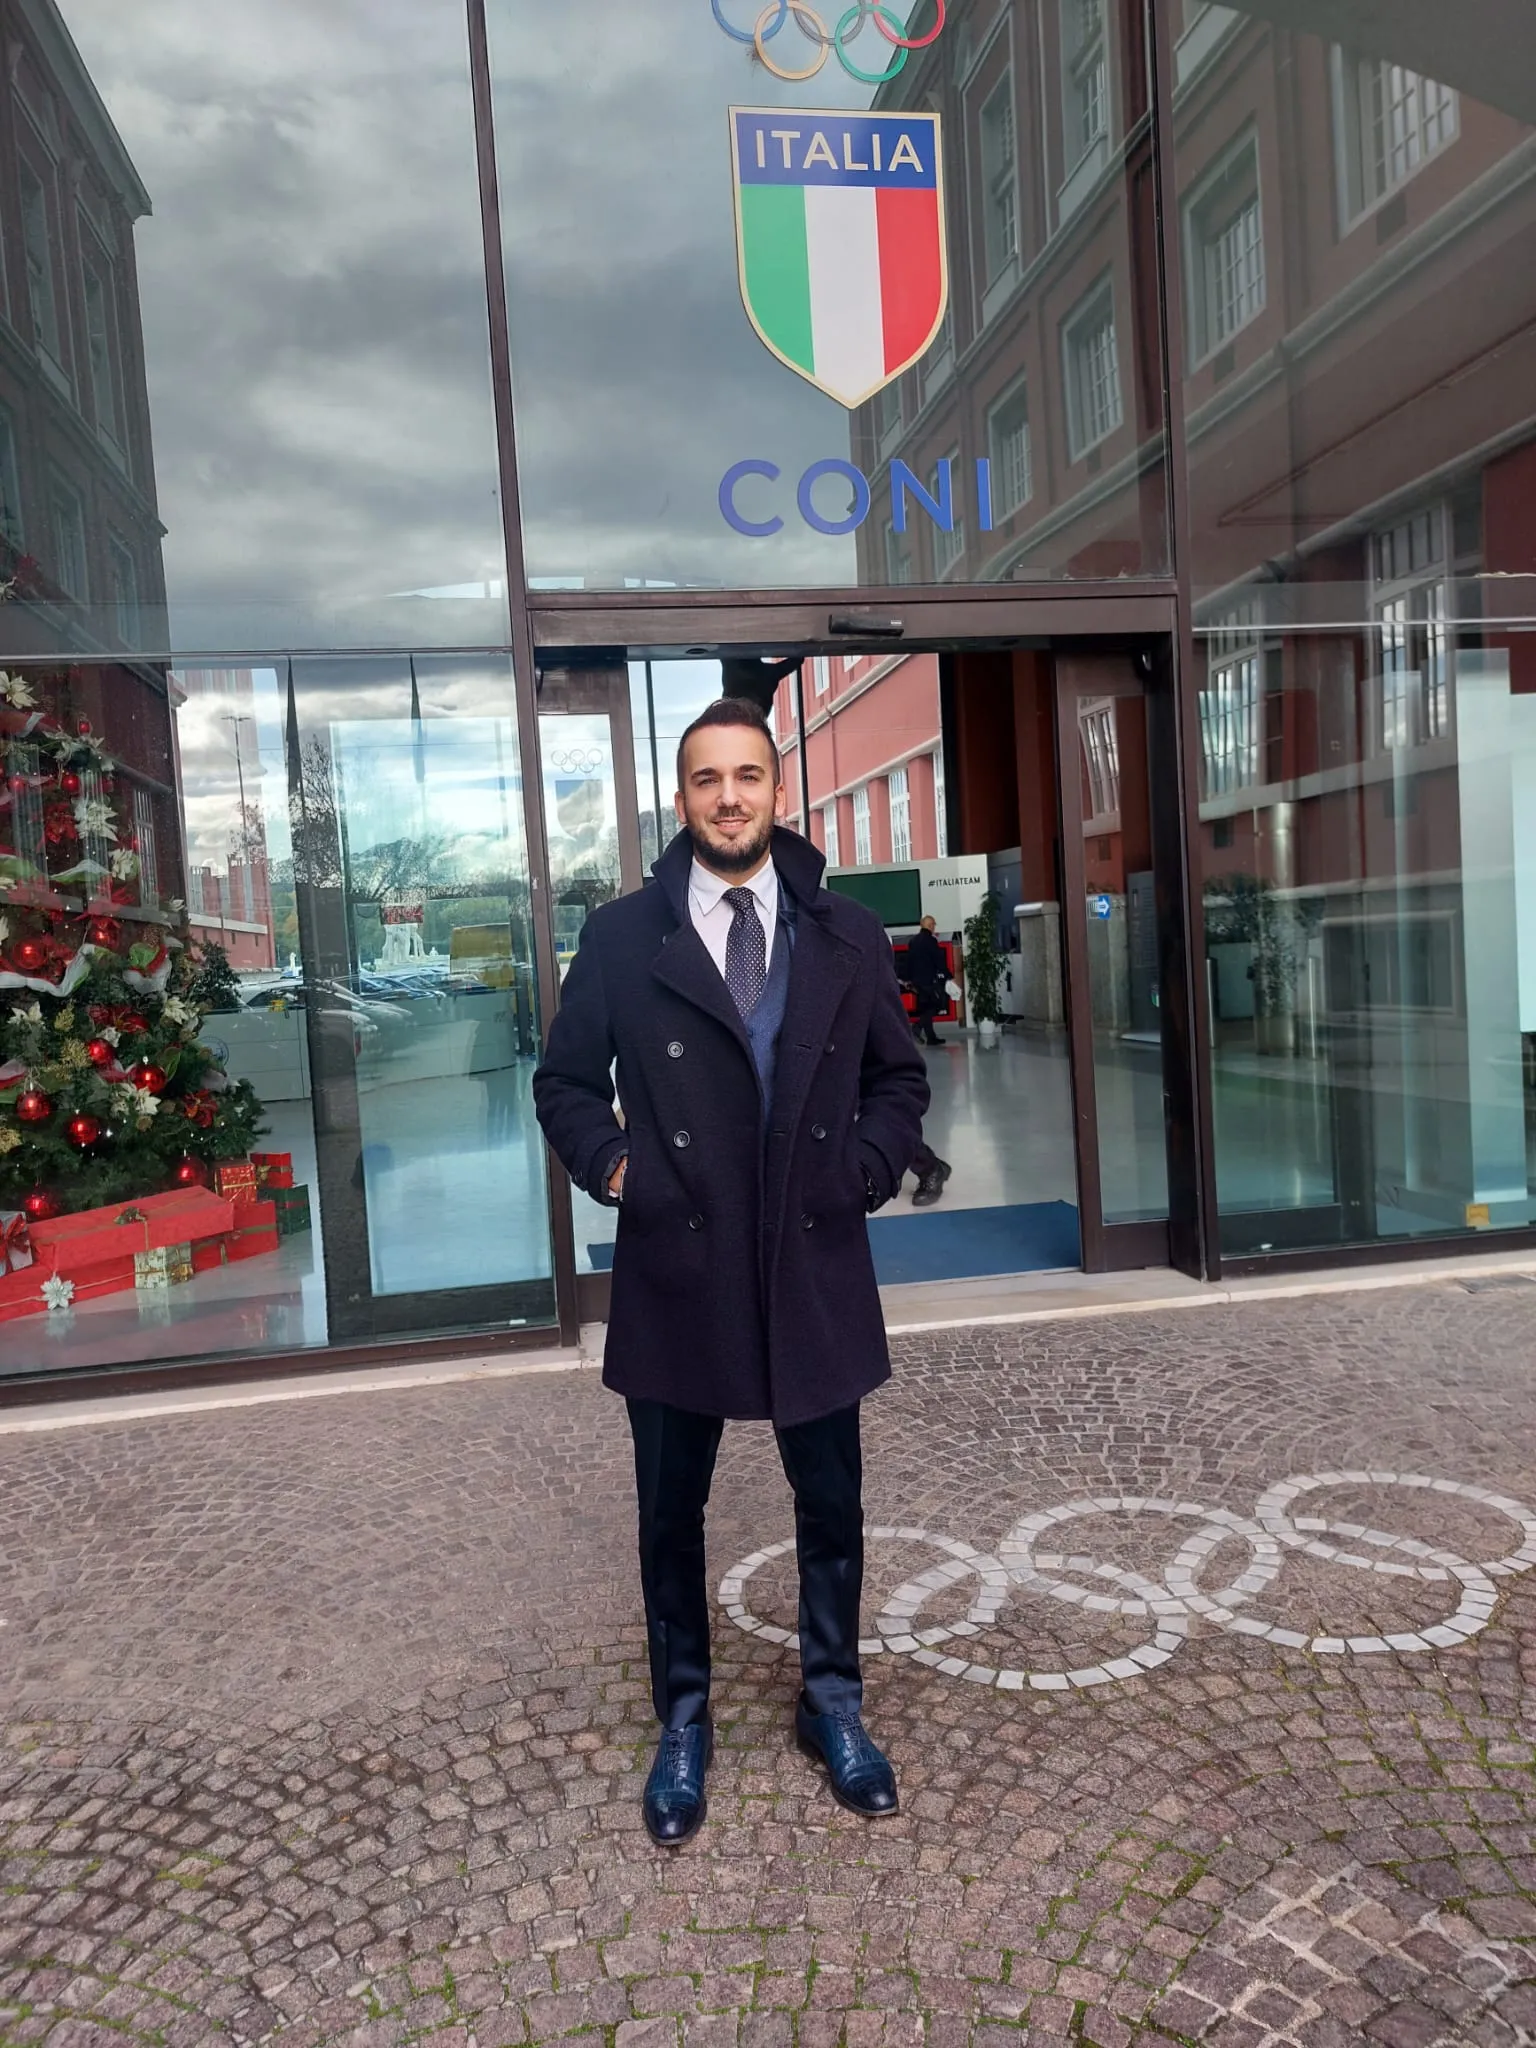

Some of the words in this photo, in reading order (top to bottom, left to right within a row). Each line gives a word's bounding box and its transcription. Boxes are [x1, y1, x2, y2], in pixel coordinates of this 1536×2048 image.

[755, 130, 923, 173] ITALIA
[718, 458, 993, 537] CONI
[928, 876, 981, 887] #ITALIATEAM
